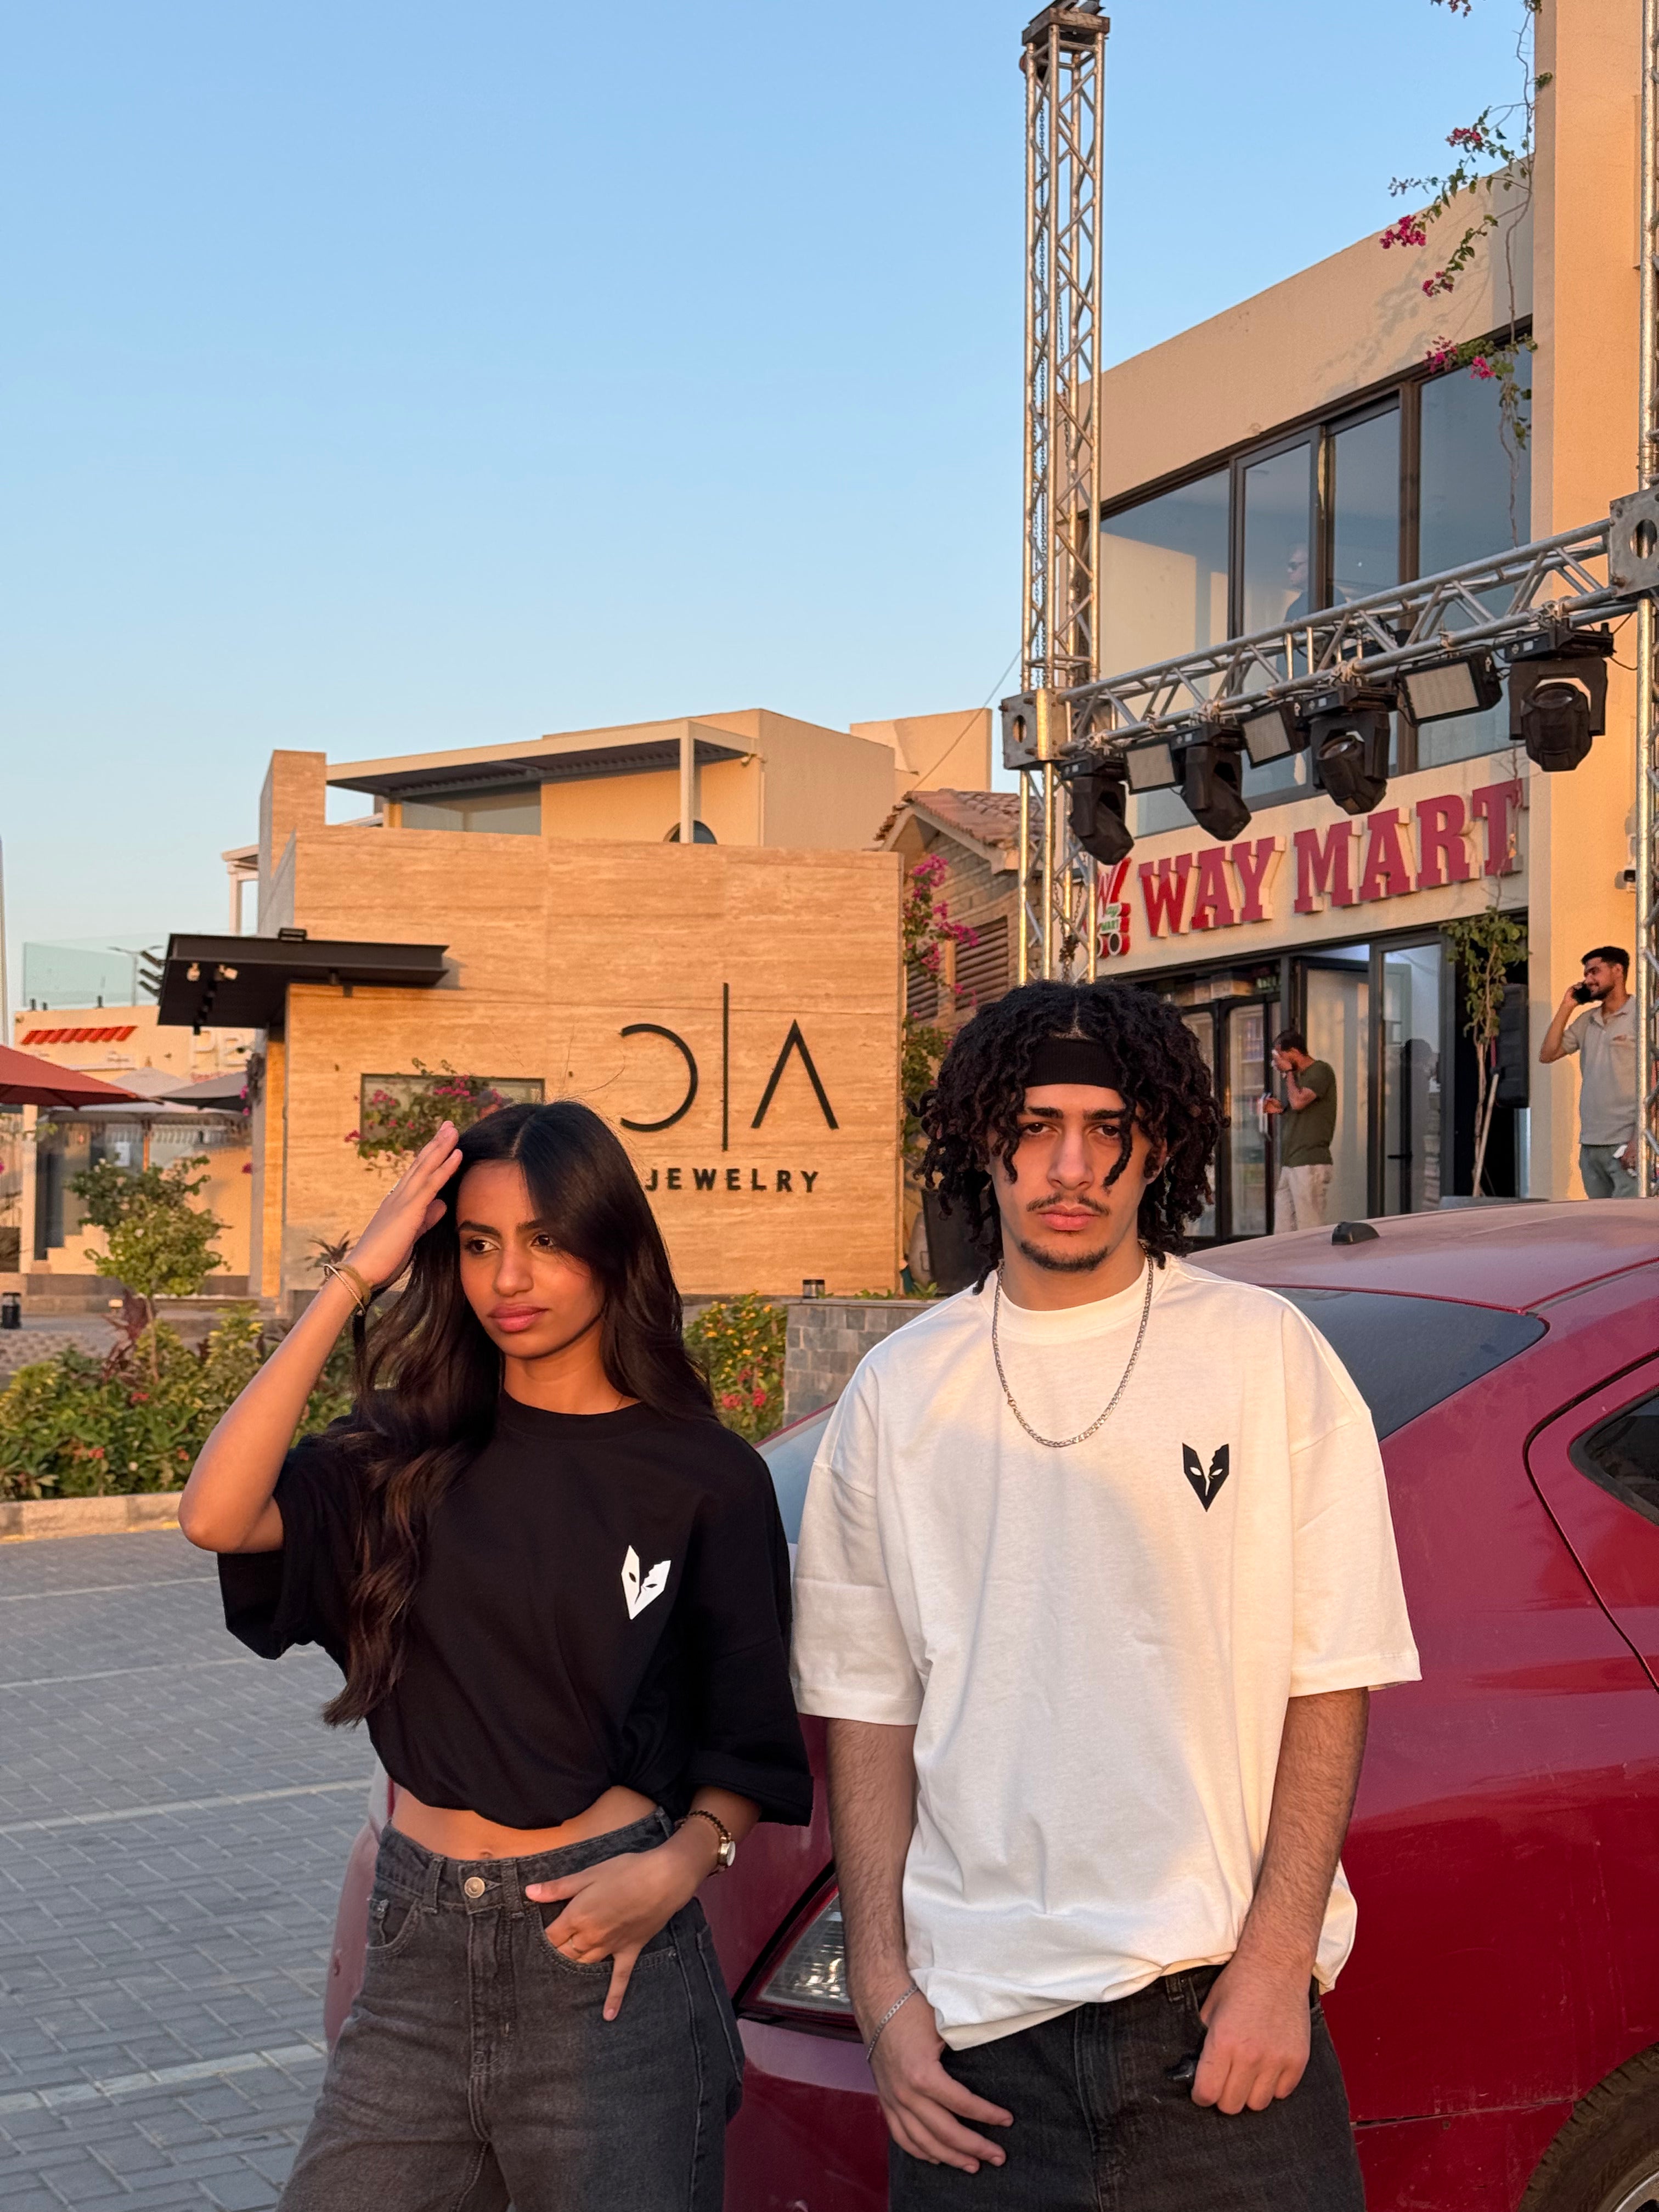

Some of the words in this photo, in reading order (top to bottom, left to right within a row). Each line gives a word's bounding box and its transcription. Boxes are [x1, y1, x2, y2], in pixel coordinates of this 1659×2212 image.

[1139, 837, 1277, 937] WAY
[1294, 779, 1523, 913] MART
[645, 1168, 819, 1193] JEWELRY
